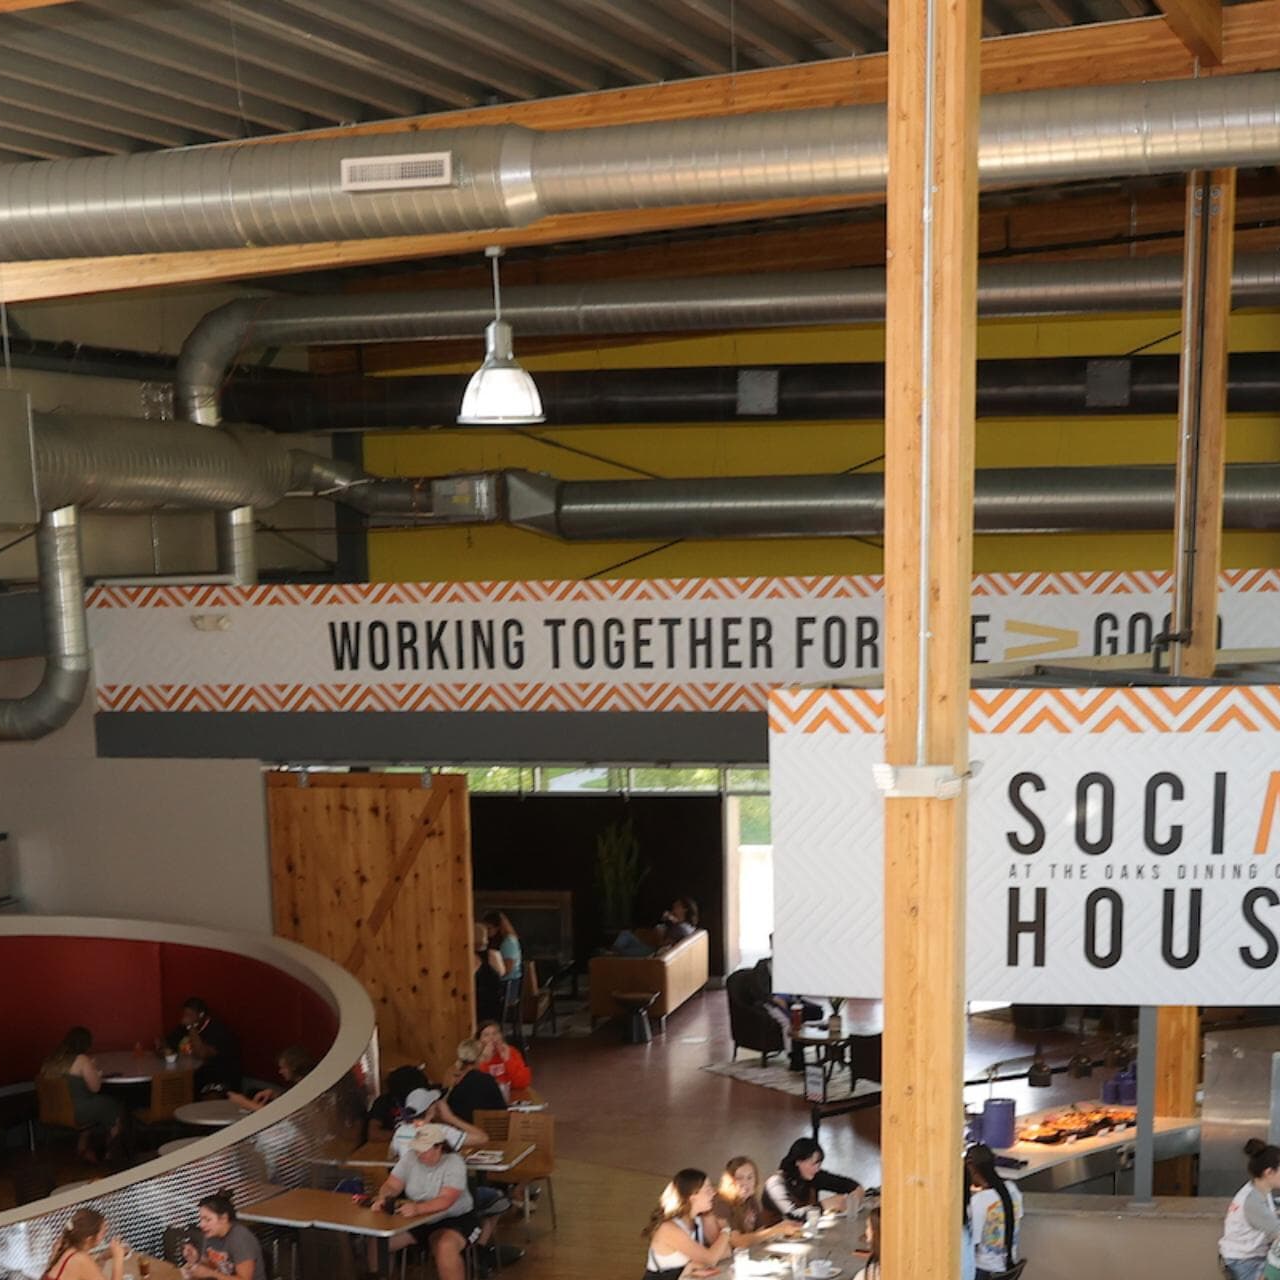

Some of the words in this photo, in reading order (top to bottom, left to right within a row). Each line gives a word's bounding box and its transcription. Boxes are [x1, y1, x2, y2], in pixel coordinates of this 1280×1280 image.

[327, 617, 526, 673] WORKING
[542, 615, 774, 671] TOGETHER
[794, 614, 880, 670] FOR
[1008, 862, 1033, 880] AT
[1049, 862, 1089, 880] THE
[1104, 863, 1161, 881] OAKS
[1177, 863, 1259, 880] DINING
